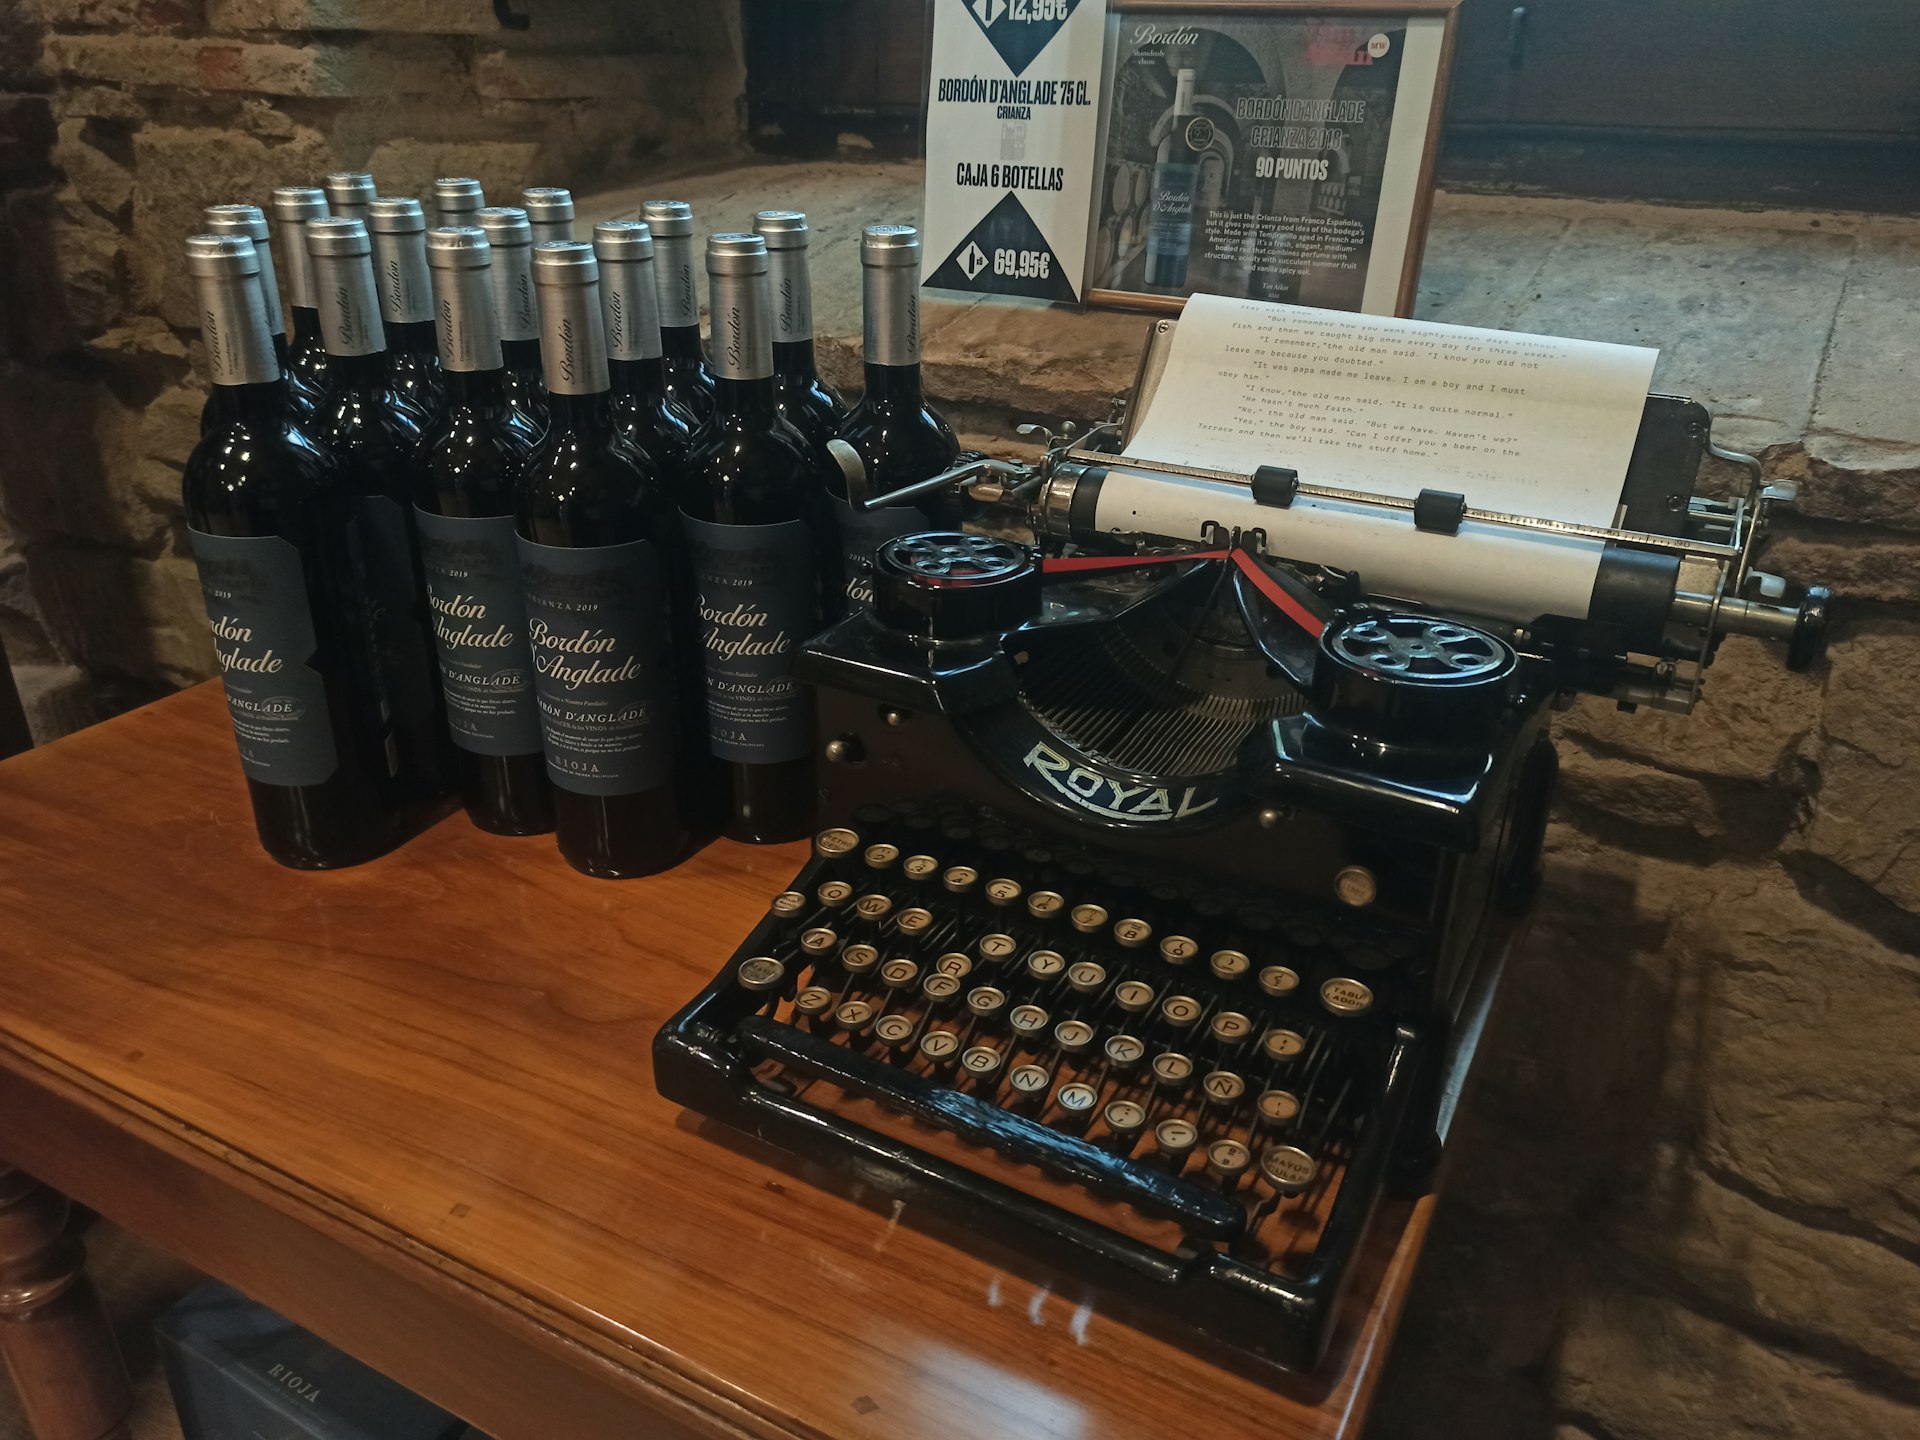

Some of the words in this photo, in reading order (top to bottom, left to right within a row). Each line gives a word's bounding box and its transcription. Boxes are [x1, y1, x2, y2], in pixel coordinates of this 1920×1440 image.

[1008, 0, 1068, 24] 12,95€
[1130, 23, 1199, 45] Bordón
[1370, 41, 1387, 50] MW
[938, 75, 987, 103] BORDÓN
[989, 80, 1058, 105] D'ANGLADE
[1061, 80, 1074, 105] 75
[1077, 80, 1091, 106] CL.
[997, 106, 1031, 120] CRIANZA
[1236, 95, 1291, 121] BORDÓN
[1292, 99, 1367, 123] D'ANGLADE
[1250, 126, 1307, 150] CRIANZA
[1307, 128, 1343, 151] 2018
[1255, 156, 1273, 178] 90
[1275, 157, 1329, 181] PUNTOS
[956, 162, 988, 187] CAJA
[991, 164, 999, 187] 6
[1002, 165, 1064, 191] BOTELLAS
[1229, 212, 1242, 220] just
[1283, 215, 1299, 223] from
[1301, 216, 1325, 224] Franco
[1327, 218, 1363, 227] Españolas,
[1225, 221, 1241, 229] gives
[1277, 224, 1294, 232] good
[1333, 227, 1365, 236] bodega's
[1205, 228, 1222, 236] style.
[1299, 233, 1315, 241] aged
[1325, 235, 1349, 243] French
[1350, 237, 1364, 245] and
[993, 248, 1050, 279] 69,95€
[386, 260, 402, 316] Bordón
[680, 263, 693, 319] Bordón
[518, 273, 532, 333] Bordón
[779, 277, 792, 334] Bordón
[336, 286, 354, 349] Bordón
[608, 290, 624, 353] Bordón
[907, 293, 916, 354] Bordón
[440, 299, 455, 363] Bordón
[728, 306, 741, 370] Bordón
[558, 318, 576, 386] Bordón
[1225, 344, 1250, 354] leave
[1271, 350, 1308, 360] because
[1334, 356, 1384, 366] doubted."
[1349, 345, 1365, 353] old
[1370, 347, 1387, 355] man
[1393, 349, 1420, 358] said.
[1444, 354, 1468, 362] know
[1474, 356, 1490, 365] you
[1497, 359, 1515, 367] did
[1521, 361, 1539, 369] not
[1218, 371, 1238, 379] obey
[1253, 361, 1268, 369] "It
[1293, 365, 1315, 375] papa
[1320, 369, 1341, 377] made
[1364, 372, 1396, 383] leave.
[1403, 376, 1408, 384] I
[1443, 381, 1460, 390] boy
[1466, 383, 1483, 391] and
[1501, 387, 1526, 396] must
[1242, 394, 1256, 403] "He
[1261, 398, 1293, 407] hasn't
[1298, 402, 1320, 410] much
[449, 569, 468, 578] 2019
[732, 579, 753, 587] 2019
[214, 589, 232, 599] 2019
[576, 603, 599, 612] 2019
[529, 617, 617, 654] Bordón
[448, 669, 520, 685] D'ANGLADE
[565, 708, 647, 724] D'ANGLADE
[555, 755, 599, 773] RIOJA
[1023, 741, 1219, 822] ROYAL
[864, 900, 884, 913] W
[906, 916, 924, 927] E
[814, 936, 826, 947] A
[991, 940, 1006, 952] T
[854, 952, 869, 965] S
[1041, 958, 1055, 970] Y
[889, 967, 907, 979] D
[943, 961, 962, 976] R
[1078, 970, 1096, 983] U
[933, 981, 952, 992] F
[802, 993, 821, 1006] Z
[976, 995, 993, 1007] G
[844, 1009, 863, 1021] X
[1172, 1004, 1189, 1017] O
[1019, 1013, 1038, 1028] H
[1221, 1020, 1239, 1032] P
[885, 1022, 903, 1037] C
[1063, 1031, 1079, 1041] J
[932, 1039, 951, 1053] V
[1115, 1044, 1134, 1058] K
[970, 1055, 989, 1068] B
[1166, 1061, 1180, 1076] L
[1019, 1073, 1038, 1088] N
[1213, 1079, 1233, 1096] Ñ
[1067, 1090, 1086, 1107] M
[267, 1363, 320, 1403] RIOJA
